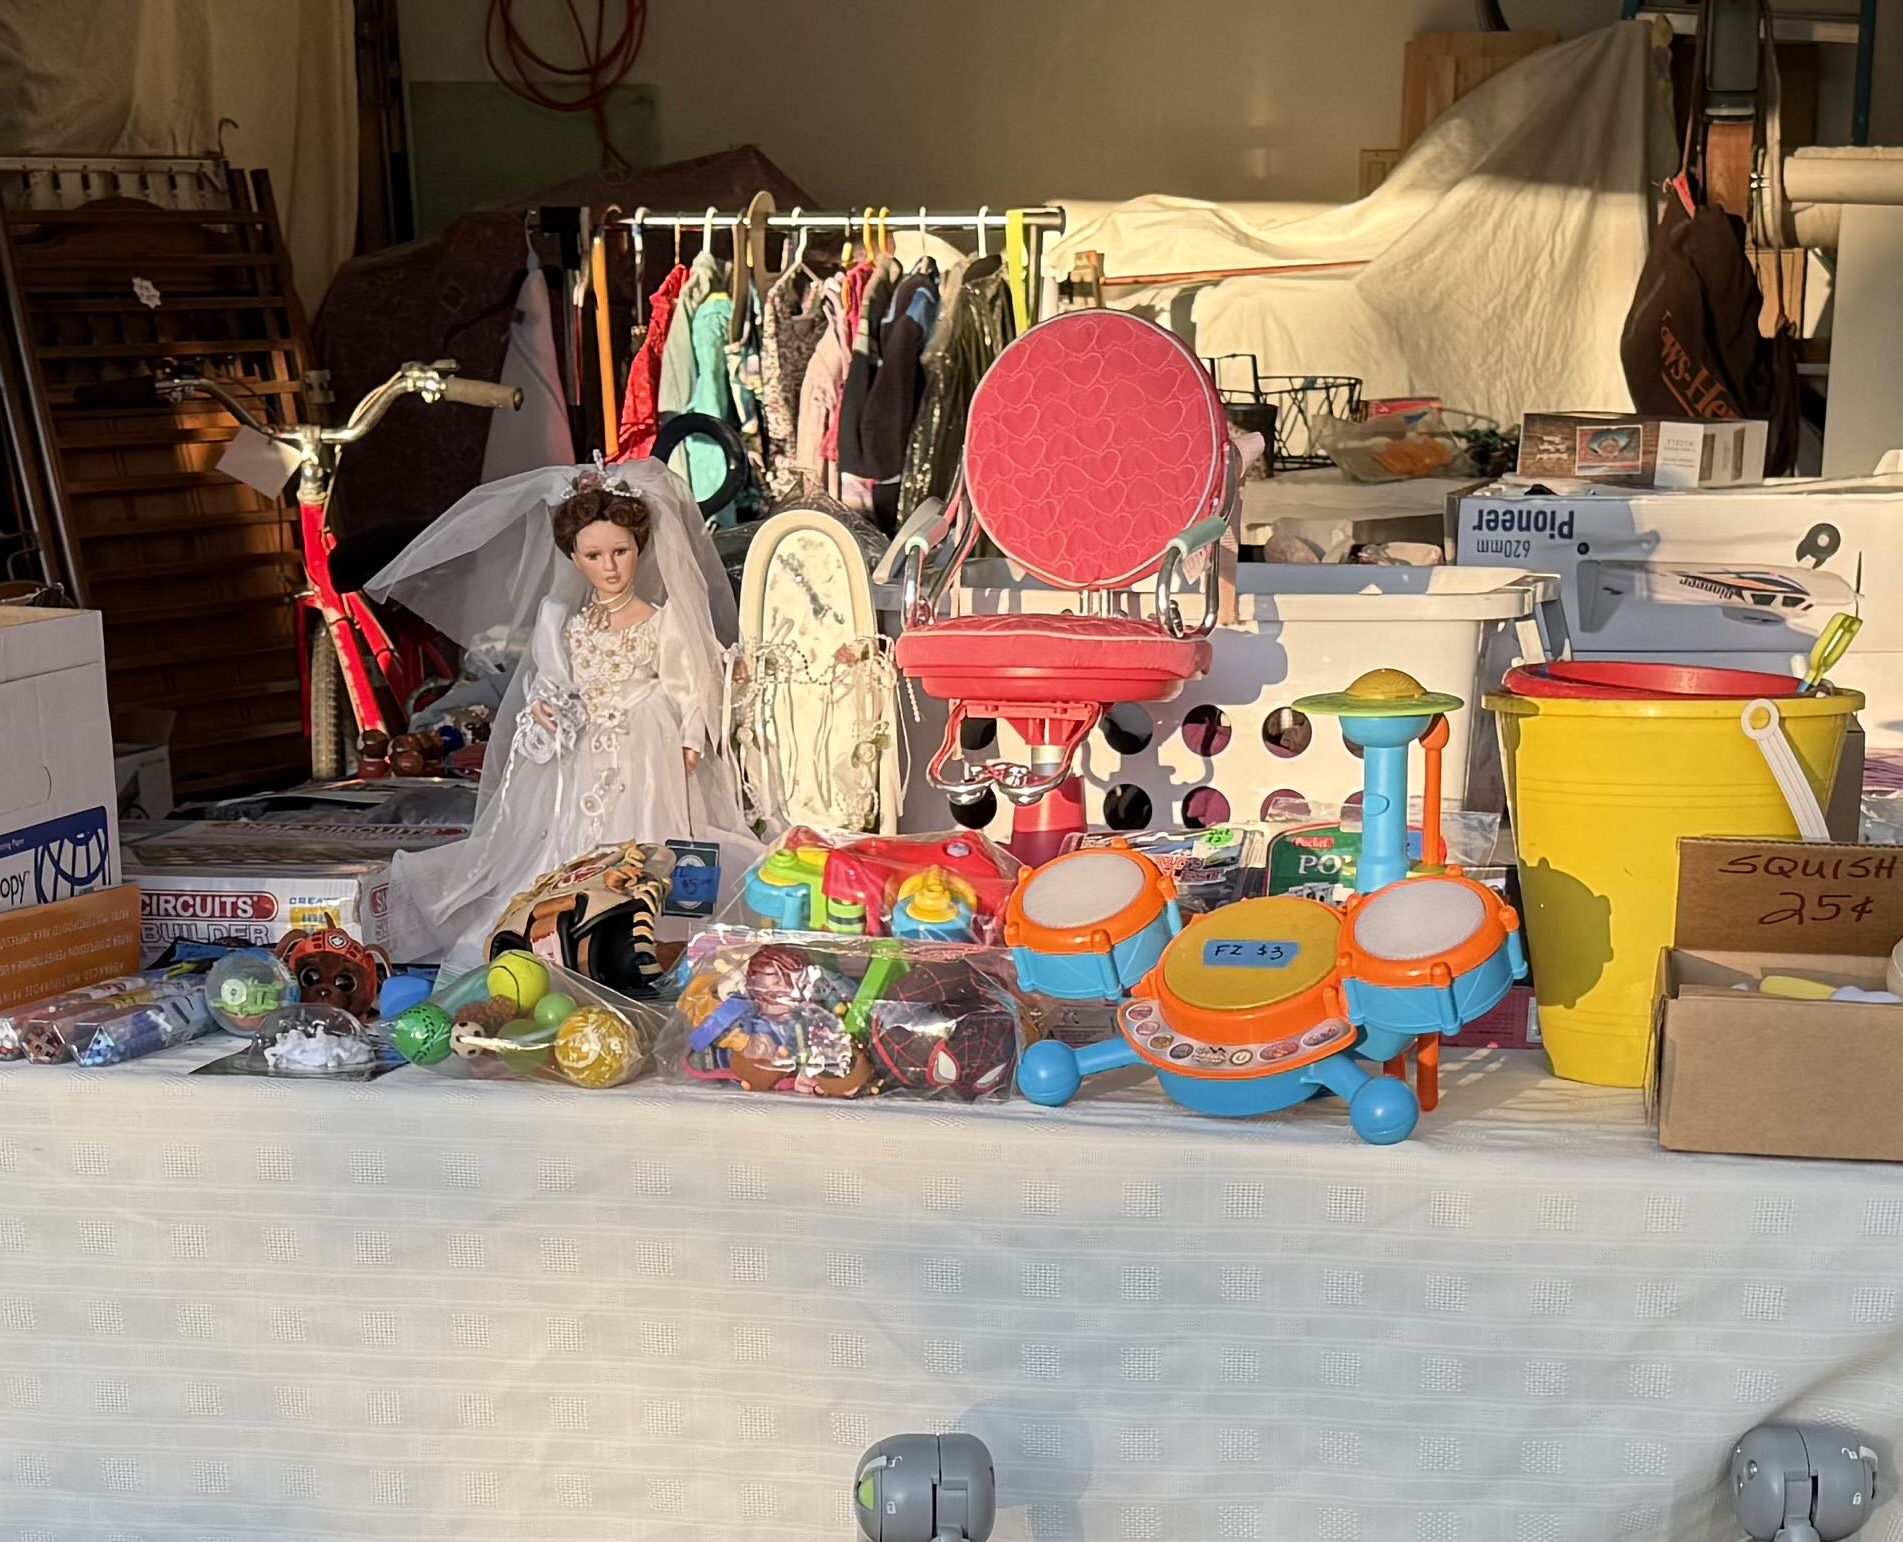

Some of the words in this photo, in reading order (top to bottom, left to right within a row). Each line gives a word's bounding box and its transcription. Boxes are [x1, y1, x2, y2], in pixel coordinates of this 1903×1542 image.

[1472, 509, 1575, 540] Pioneer
[1477, 540, 1531, 558] 620mm
[141, 895, 254, 919] CIRCUITS
[1757, 890, 1876, 926] 25¢
[141, 923, 270, 946] BUILDER
[1214, 944, 1243, 957] FZ
[1257, 944, 1283, 960] $3
